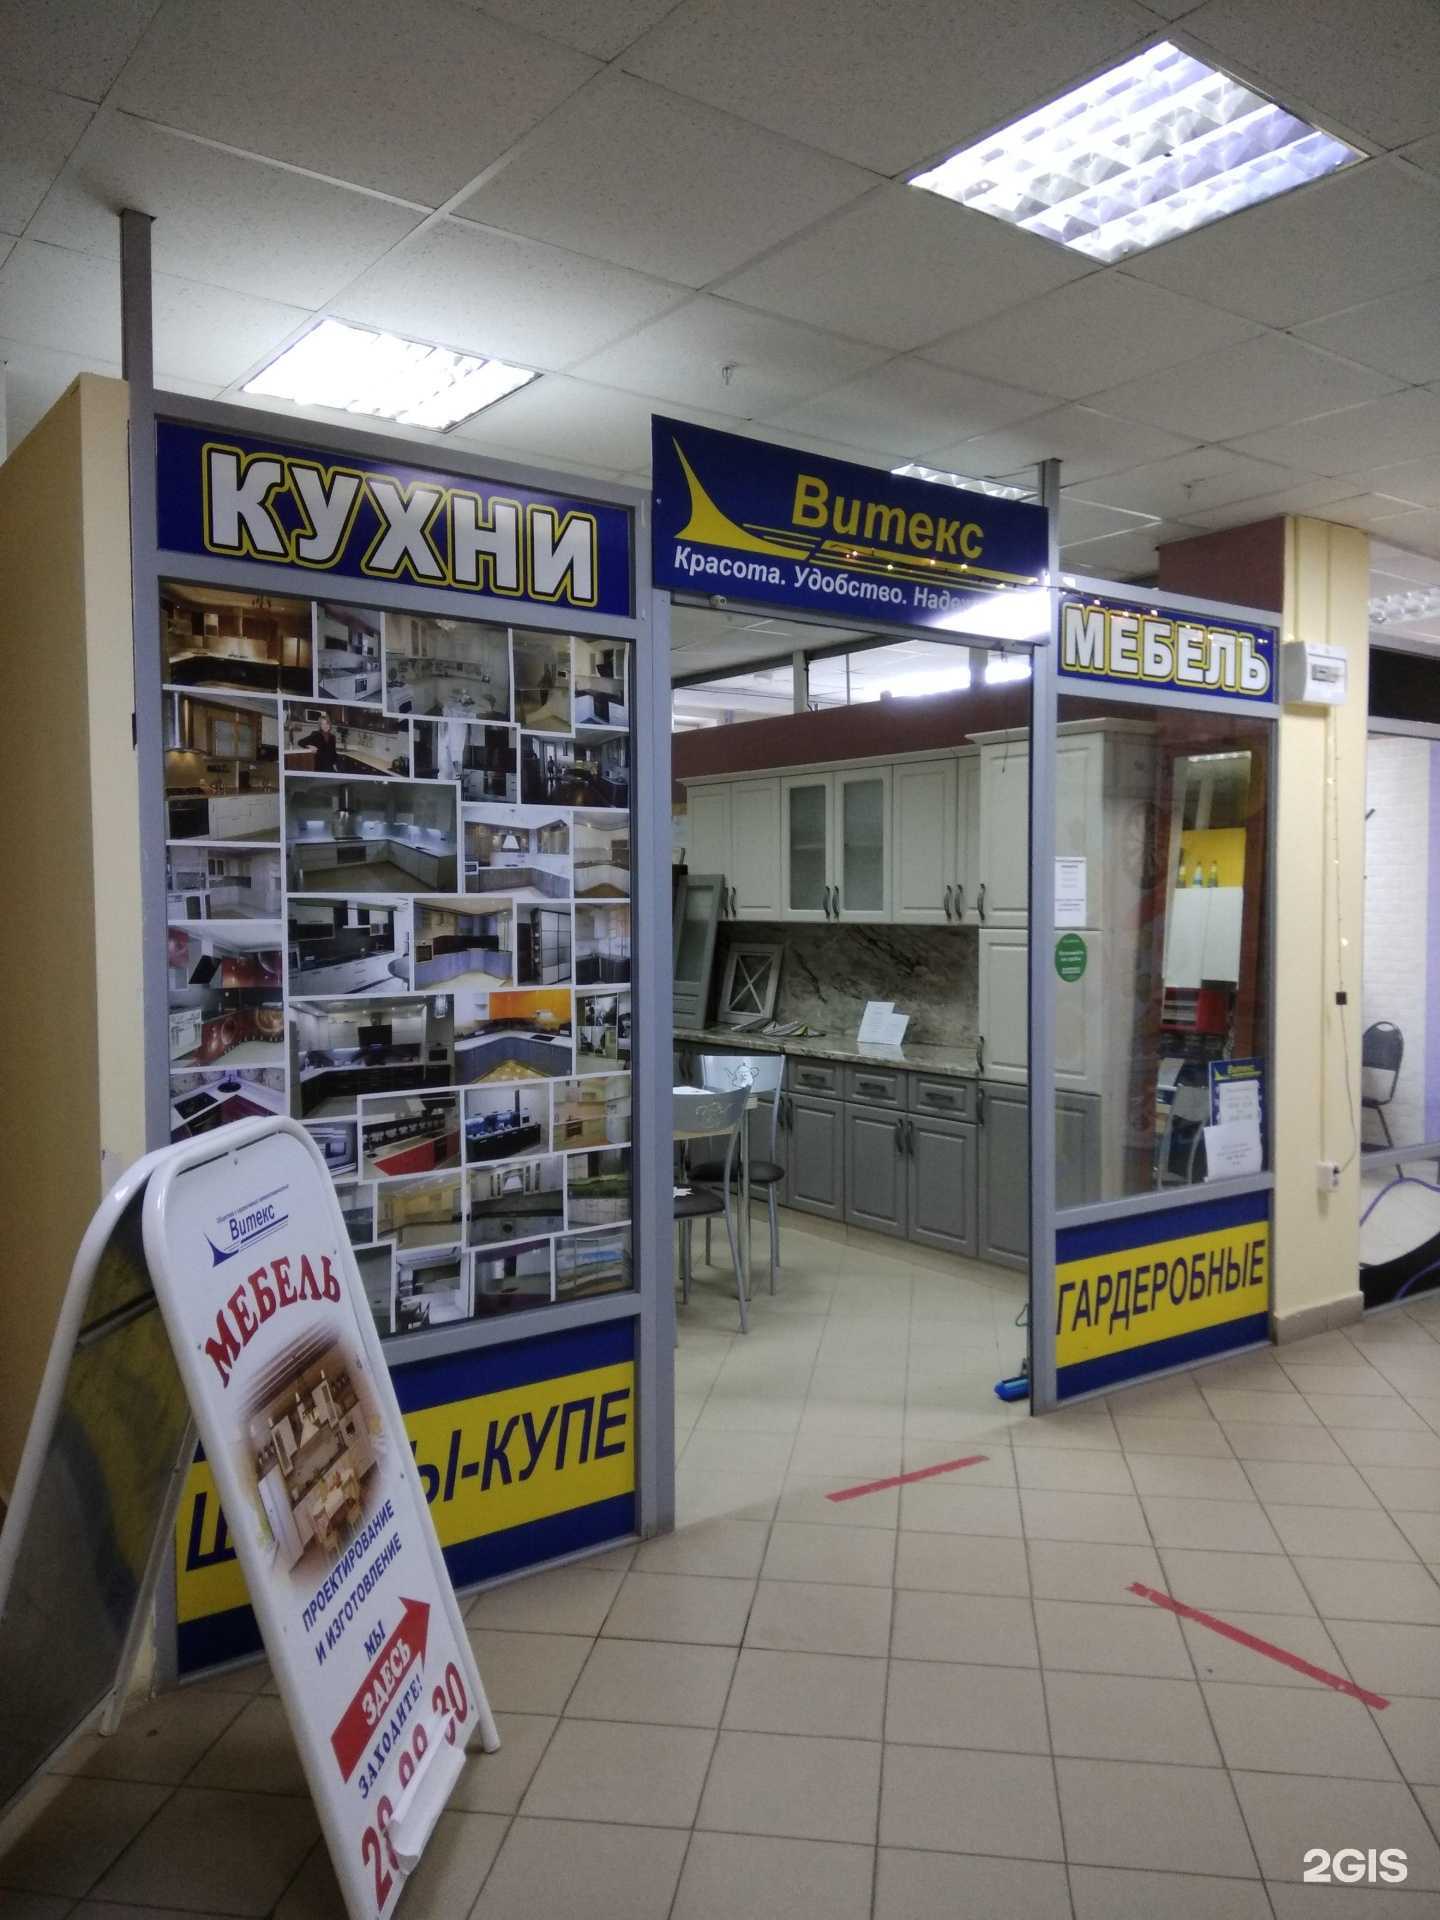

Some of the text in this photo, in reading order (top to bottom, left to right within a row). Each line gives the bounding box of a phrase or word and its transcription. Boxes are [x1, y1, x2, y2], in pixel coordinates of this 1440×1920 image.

[204, 444, 597, 606] КУХНИ
[791, 474, 984, 558] Витекс
[674, 545, 786, 585] Красота.
[794, 565, 907, 605] Удобство.
[1061, 603, 1270, 695] МЕБЕЛЬ
[229, 1204, 275, 1241] Витекс
[205, 1254, 341, 1388] МЕБЕЛЬ
[1056, 1240, 1265, 1335] ГАРДЕРОБНЫЕ
[302, 1499, 395, 1632] ПРОЕКТИРОВАНИЕ
[315, 1532, 403, 1666] И ИЗГОТОВЛЕНИЕ
[361, 1638, 411, 1726] ЗДЕСЬ
[363, 1619, 386, 1661] МЫ
[358, 1673, 423, 1799] ЗАХОДИТЕ!
